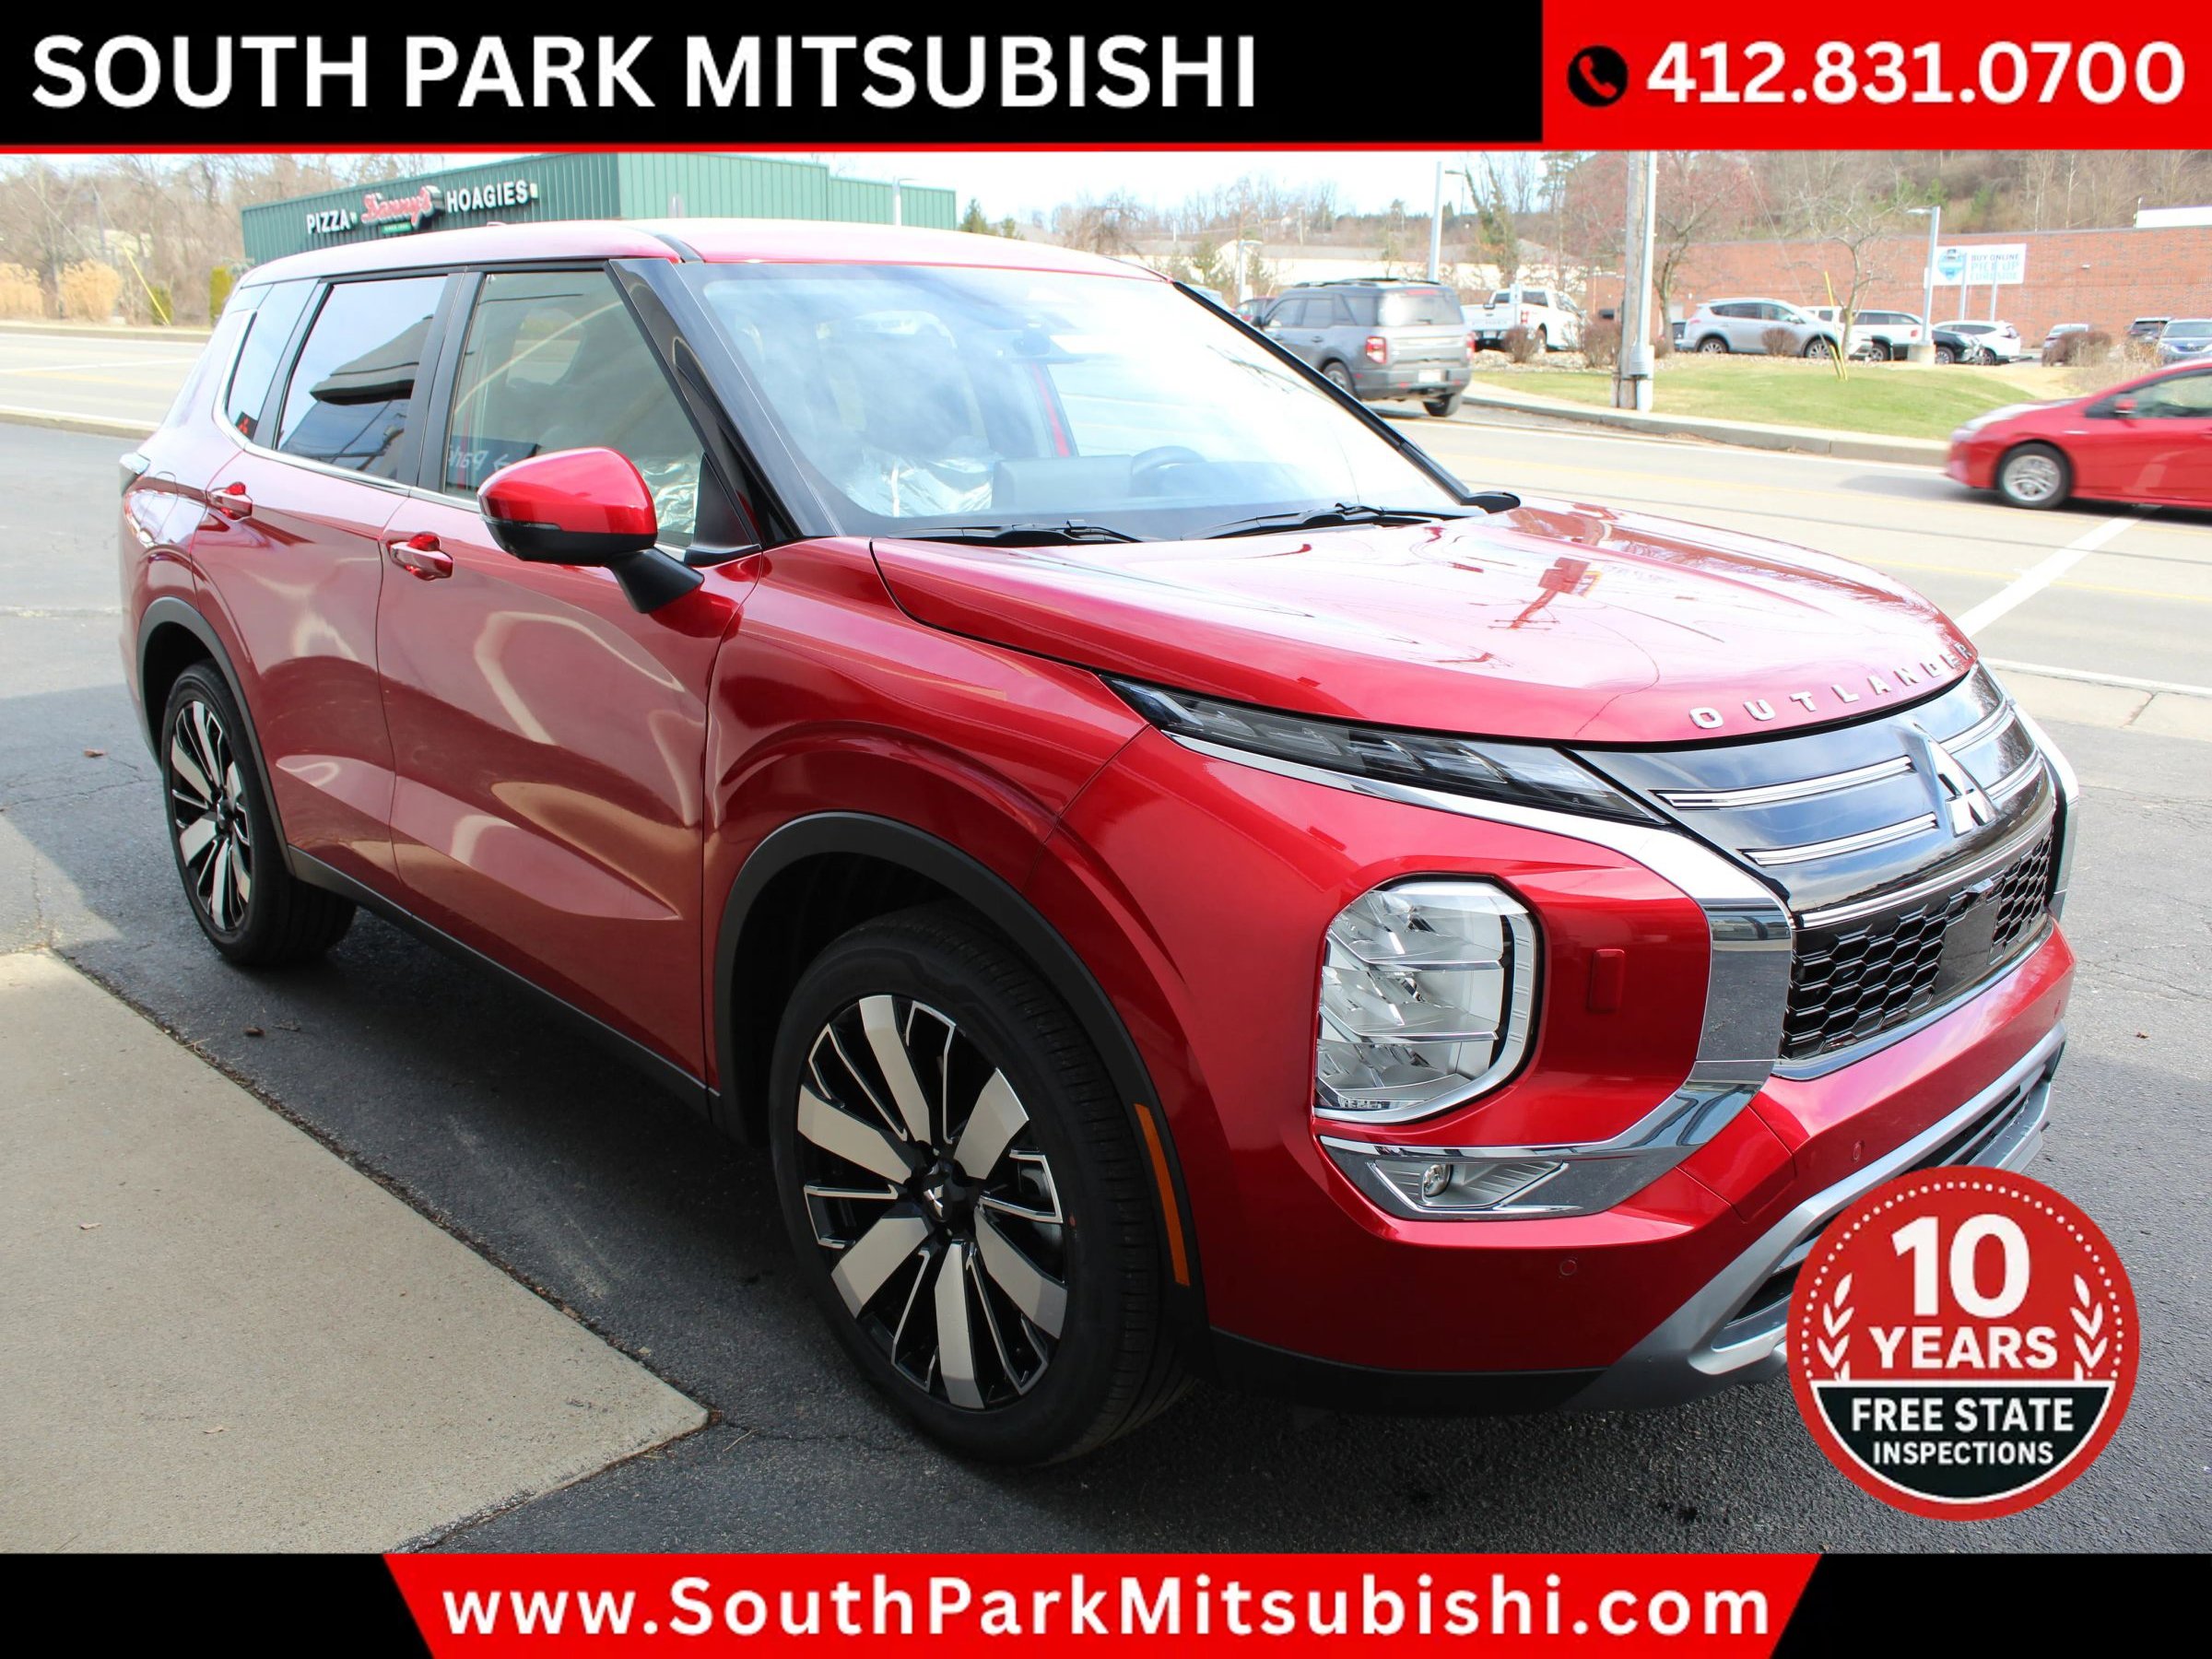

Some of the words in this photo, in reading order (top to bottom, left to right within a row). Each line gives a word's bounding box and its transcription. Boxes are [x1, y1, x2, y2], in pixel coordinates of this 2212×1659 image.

[306, 208, 351, 234] PIZZA
[446, 179, 529, 213] HOAGIES
[1971, 253, 1988, 262] BUY
[1990, 253, 2019, 262] ONLINE
[1688, 641, 1972, 729] OUTLANDER
